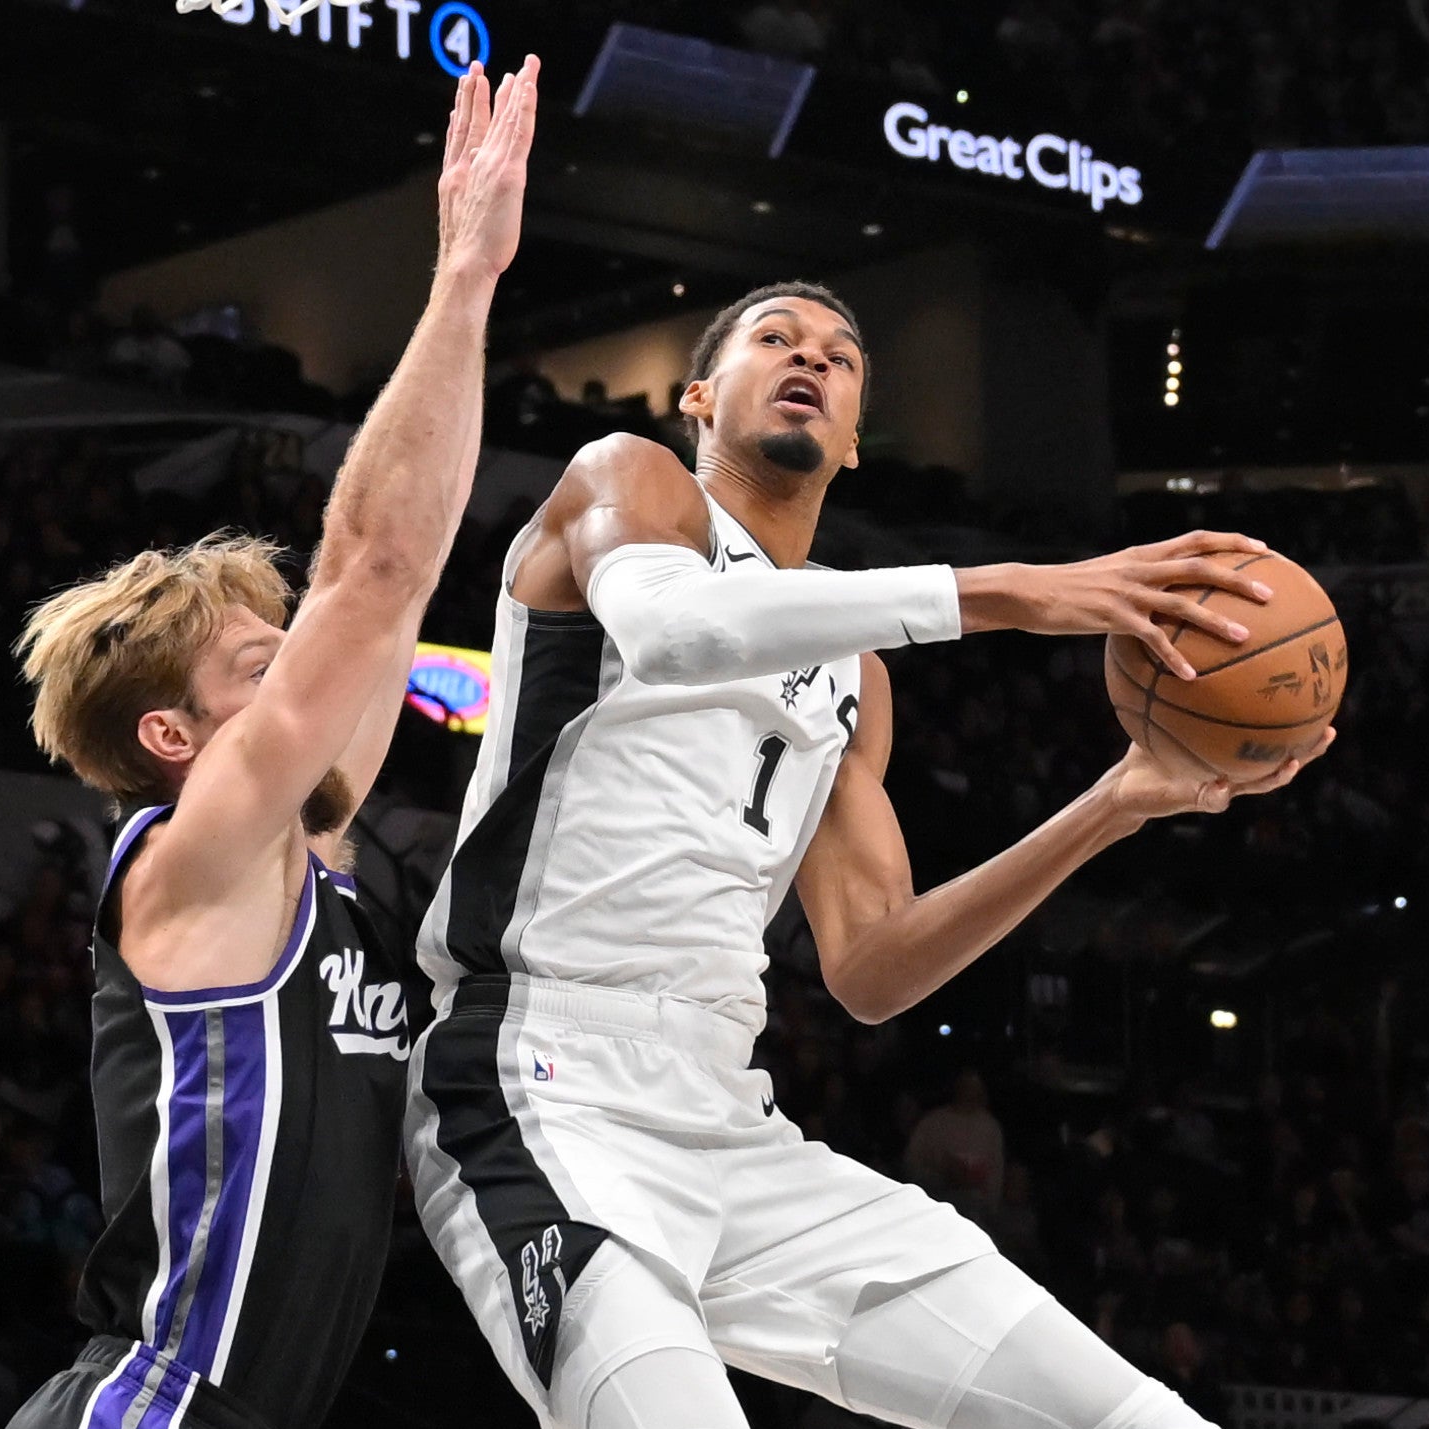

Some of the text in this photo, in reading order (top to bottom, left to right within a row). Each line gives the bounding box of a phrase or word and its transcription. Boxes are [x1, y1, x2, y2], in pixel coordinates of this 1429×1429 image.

[884, 102, 1142, 212] Great Clips
[737, 729, 792, 846] 1
